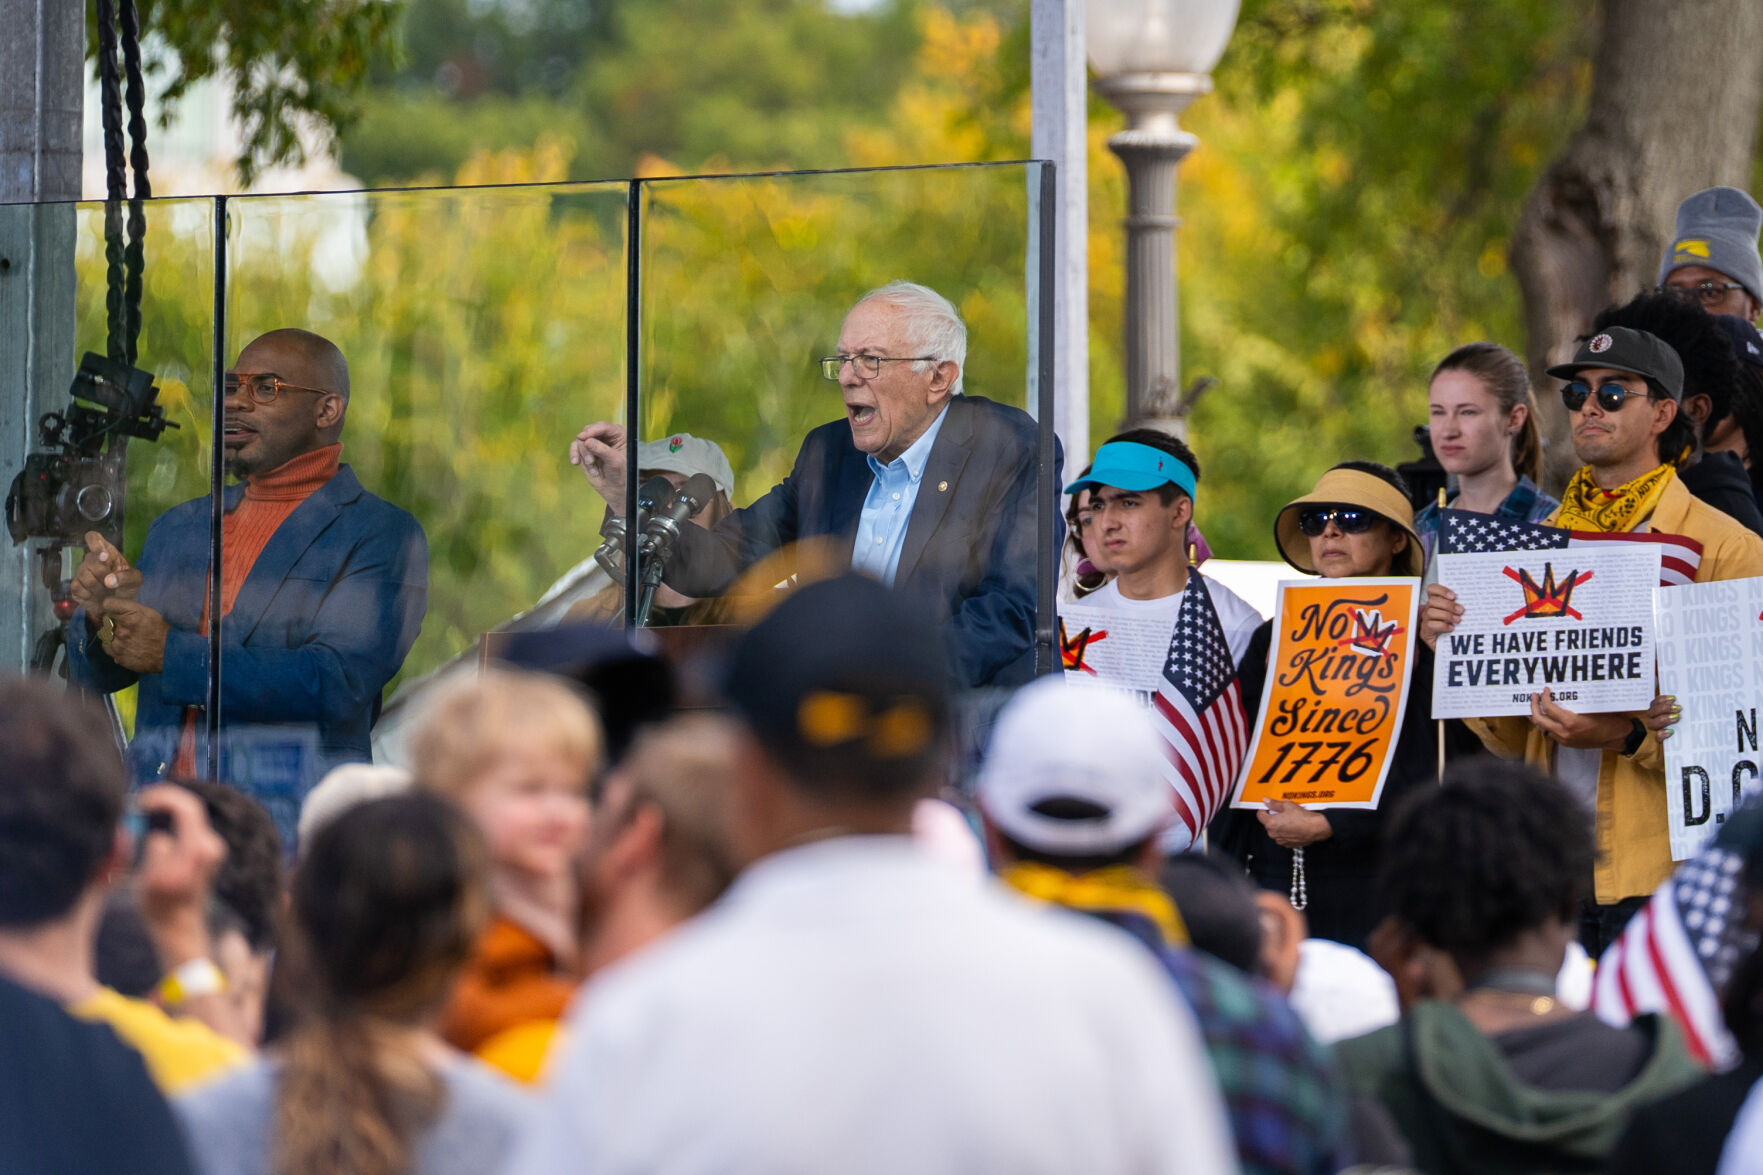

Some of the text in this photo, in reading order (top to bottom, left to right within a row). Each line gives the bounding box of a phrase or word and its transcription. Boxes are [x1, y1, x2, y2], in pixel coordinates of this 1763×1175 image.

[1681, 581, 1739, 607] KINGS
[1291, 593, 1388, 642] No
[1682, 605, 1741, 635] KINGS
[1450, 626, 1643, 656] WE HAVE FRIENDS
[1685, 633, 1743, 664] KINGS
[1279, 646, 1399, 697] Kings
[1448, 652, 1642, 687] EVERYWHERE
[1687, 662, 1745, 693] KINGS
[1512, 691, 1578, 703] NOKS.ORG
[1270, 695, 1390, 737] Since
[1691, 718, 1736, 749] KING
[1257, 738, 1379, 783] 1776
